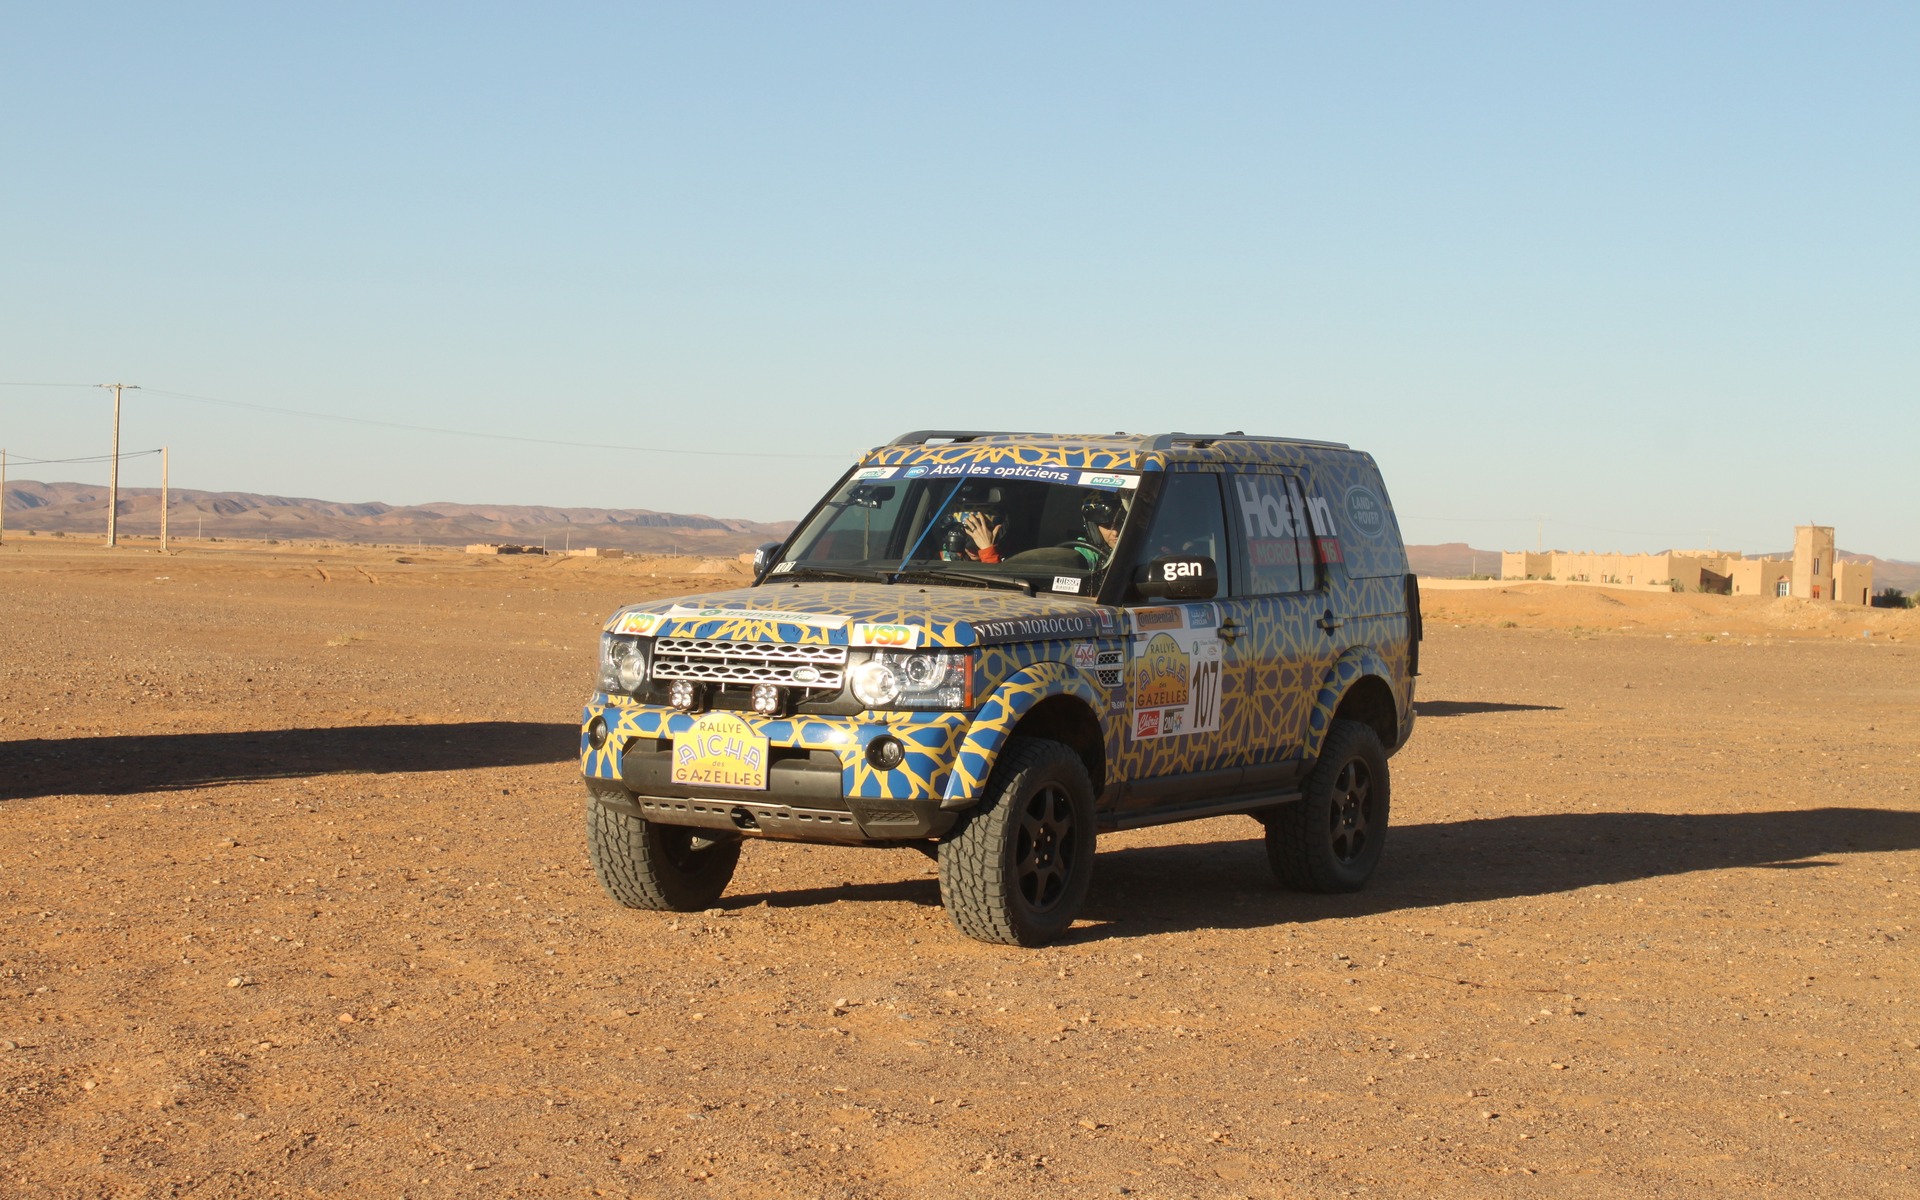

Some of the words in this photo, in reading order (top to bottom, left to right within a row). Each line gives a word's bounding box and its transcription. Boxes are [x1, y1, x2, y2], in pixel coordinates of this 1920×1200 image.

[930, 463, 966, 475] Atol
[967, 463, 991, 475] les
[994, 466, 1070, 481] opticiens
[1092, 476, 1124, 487] MDJS
[1351, 495, 1371, 510] LAND
[1357, 511, 1380, 526] ROVER
[1163, 562, 1203, 582] gan
[621, 612, 657, 634] VSD
[723, 609, 813, 623] transavia
[1138, 611, 1176, 627] Continental
[861, 624, 912, 647] VSD
[973, 621, 1016, 639] VISIT
[1018, 616, 1084, 635] MOROCCO
[1150, 642, 1175, 654] RALLYE
[1138, 689, 1188, 707] GAZELLES
[1192, 660, 1219, 729] 107
[699, 721, 743, 734] RALLYE
[711, 760, 727, 768] des
[675, 768, 763, 787] GAZELLES
